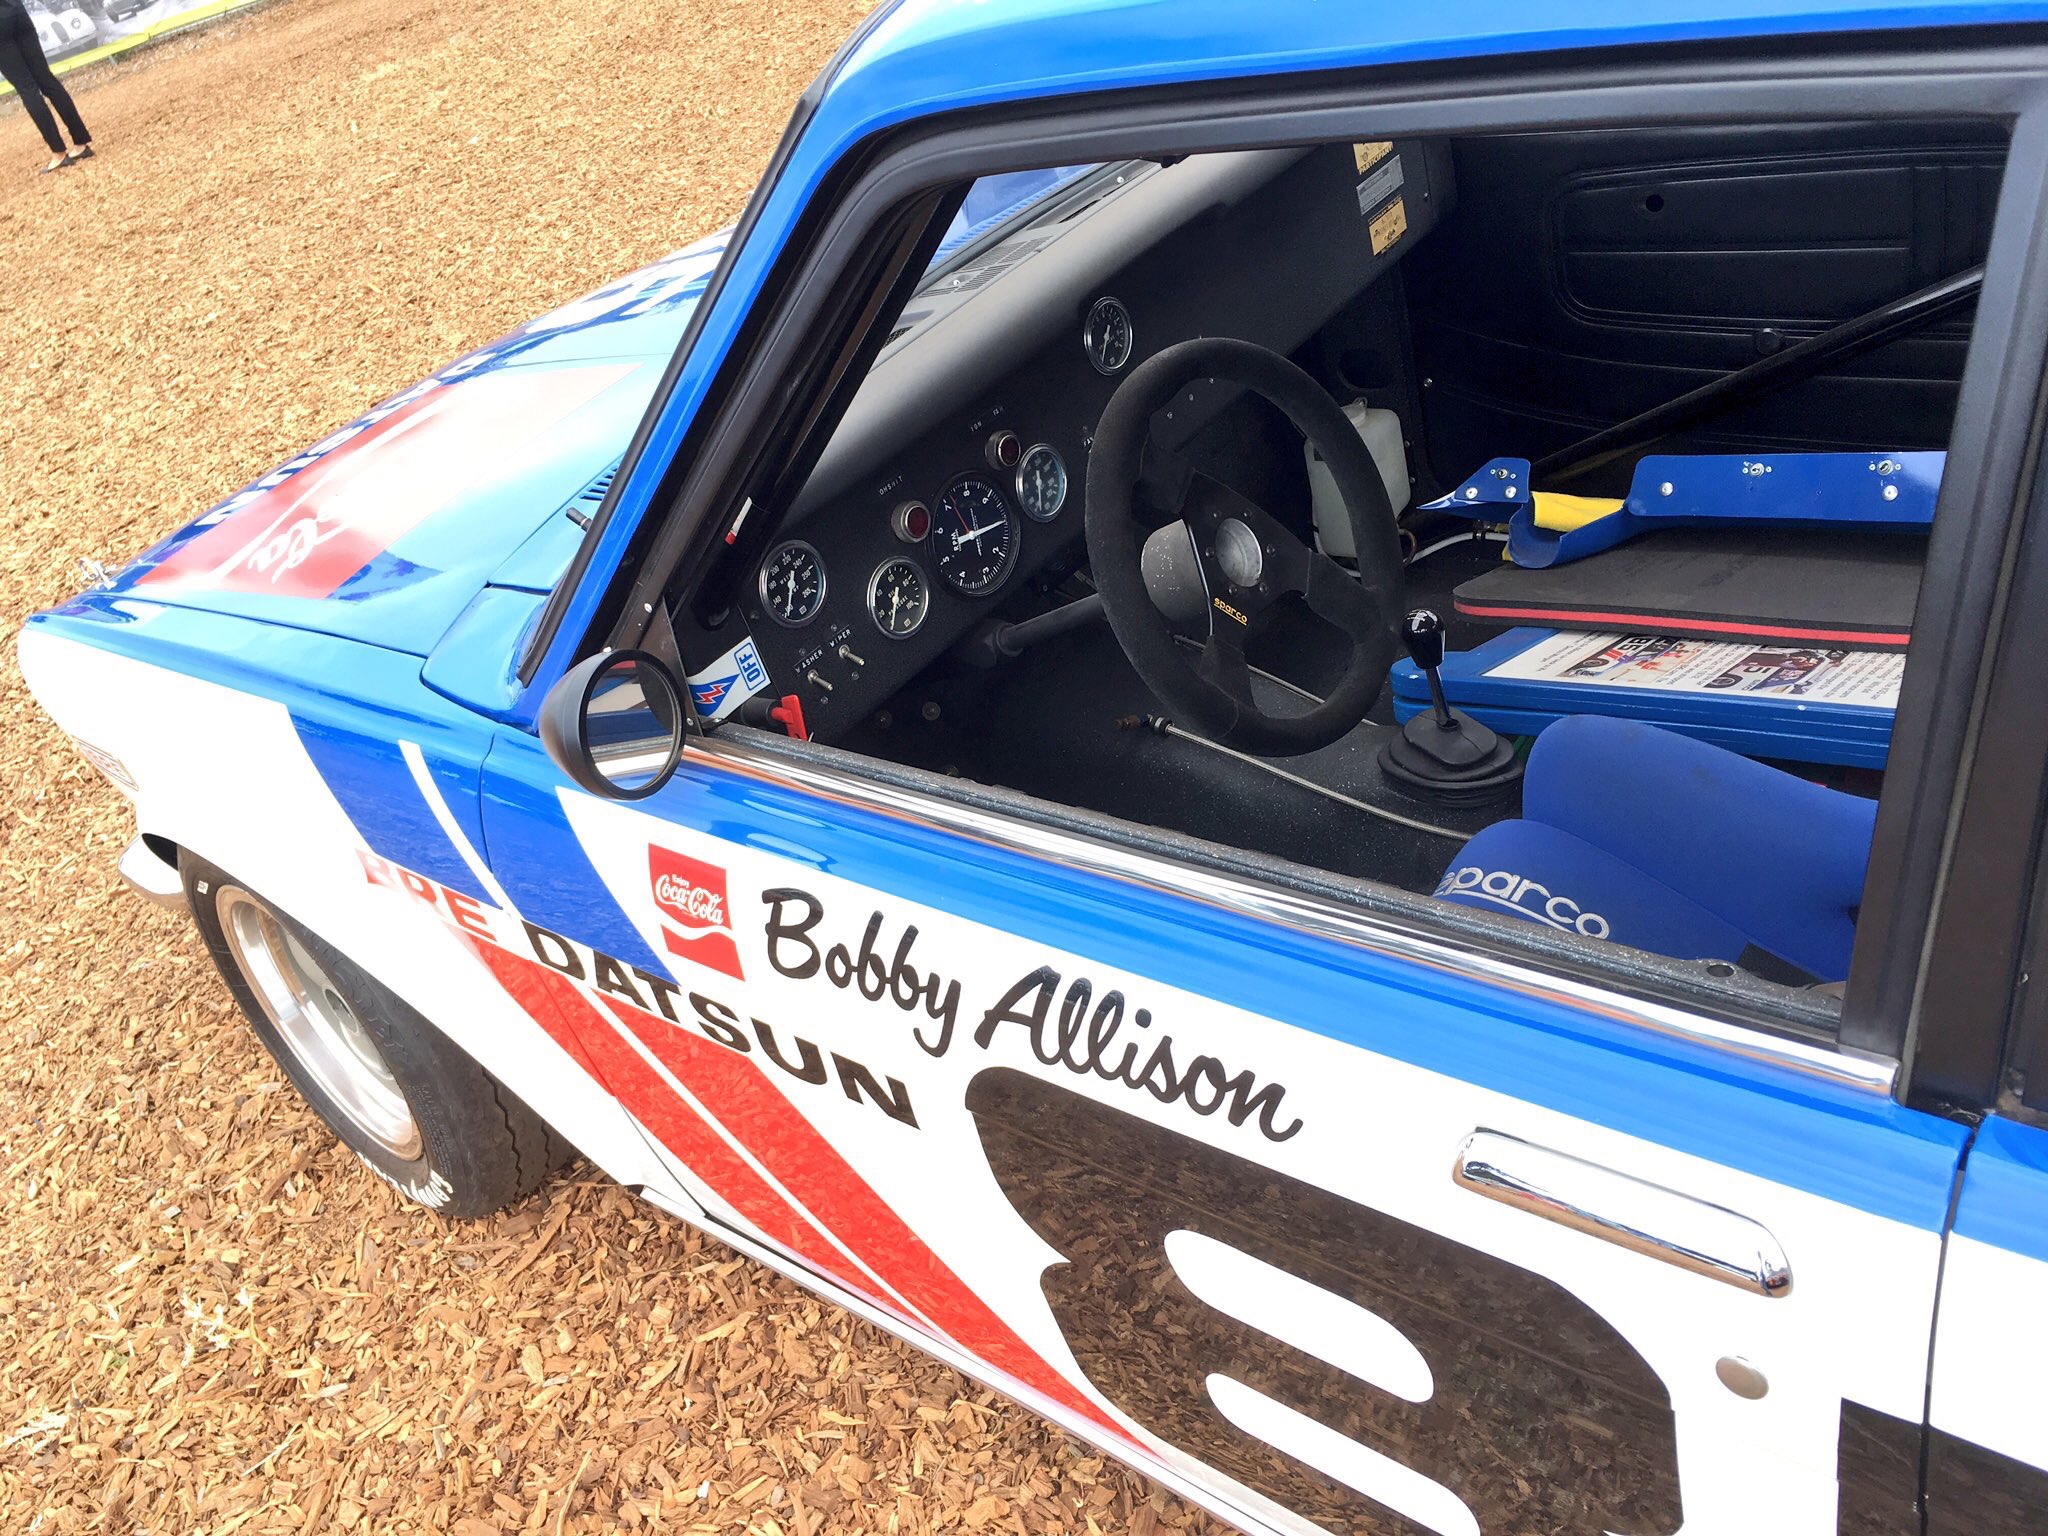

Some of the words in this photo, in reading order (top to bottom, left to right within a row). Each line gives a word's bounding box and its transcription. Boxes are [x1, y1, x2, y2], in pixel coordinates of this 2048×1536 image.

[1214, 597, 1248, 624] sparco
[829, 629, 851, 648] WIPER
[738, 652, 761, 683] OFF
[795, 649, 823, 674] WASHER
[672, 874, 690, 888] Enjoy
[655, 874, 724, 925] Coca-Cola
[521, 919, 921, 1130] DATSUN
[761, 887, 961, 1058] Bobby
[973, 965, 1303, 1142] Allison
